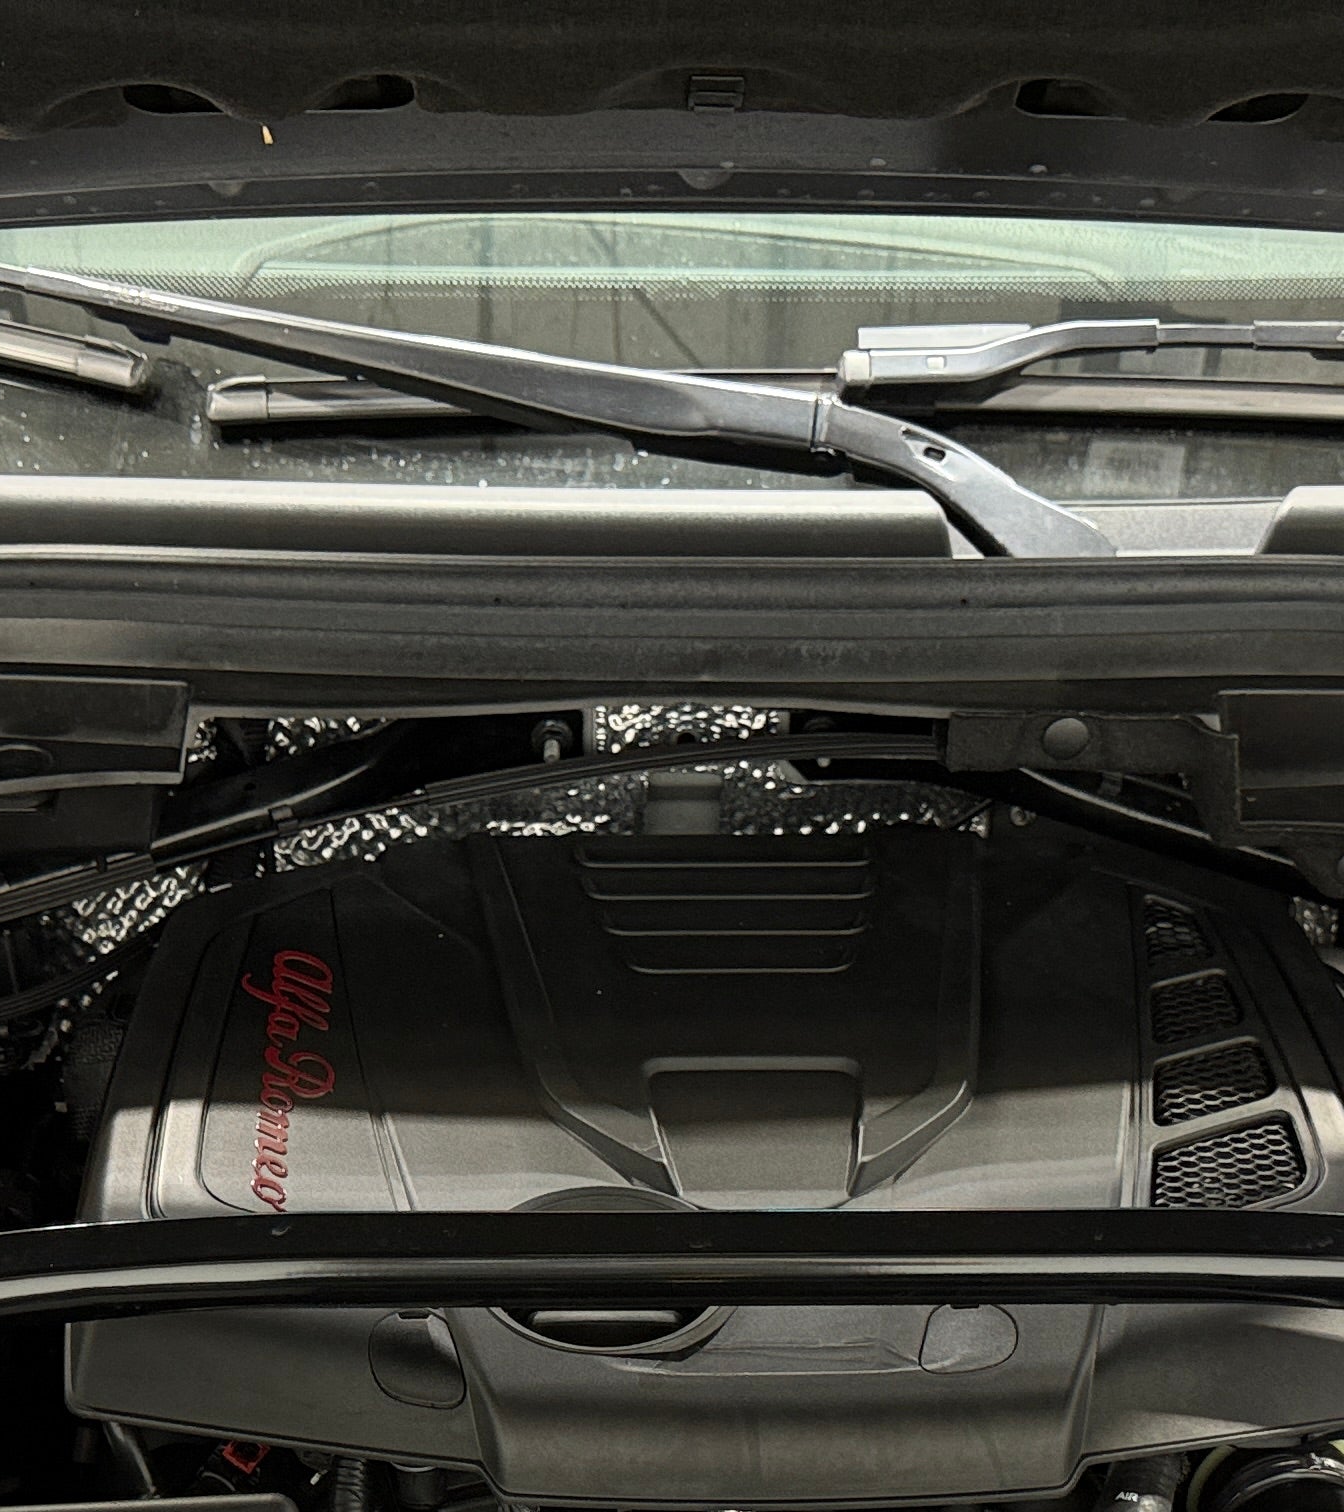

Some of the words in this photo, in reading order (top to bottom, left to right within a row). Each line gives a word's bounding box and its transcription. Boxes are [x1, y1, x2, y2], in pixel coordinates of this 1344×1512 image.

[241, 950, 334, 1048] Alfa
[251, 1047, 335, 1212] Romeo
[1114, 1491, 1139, 1503] AIR
